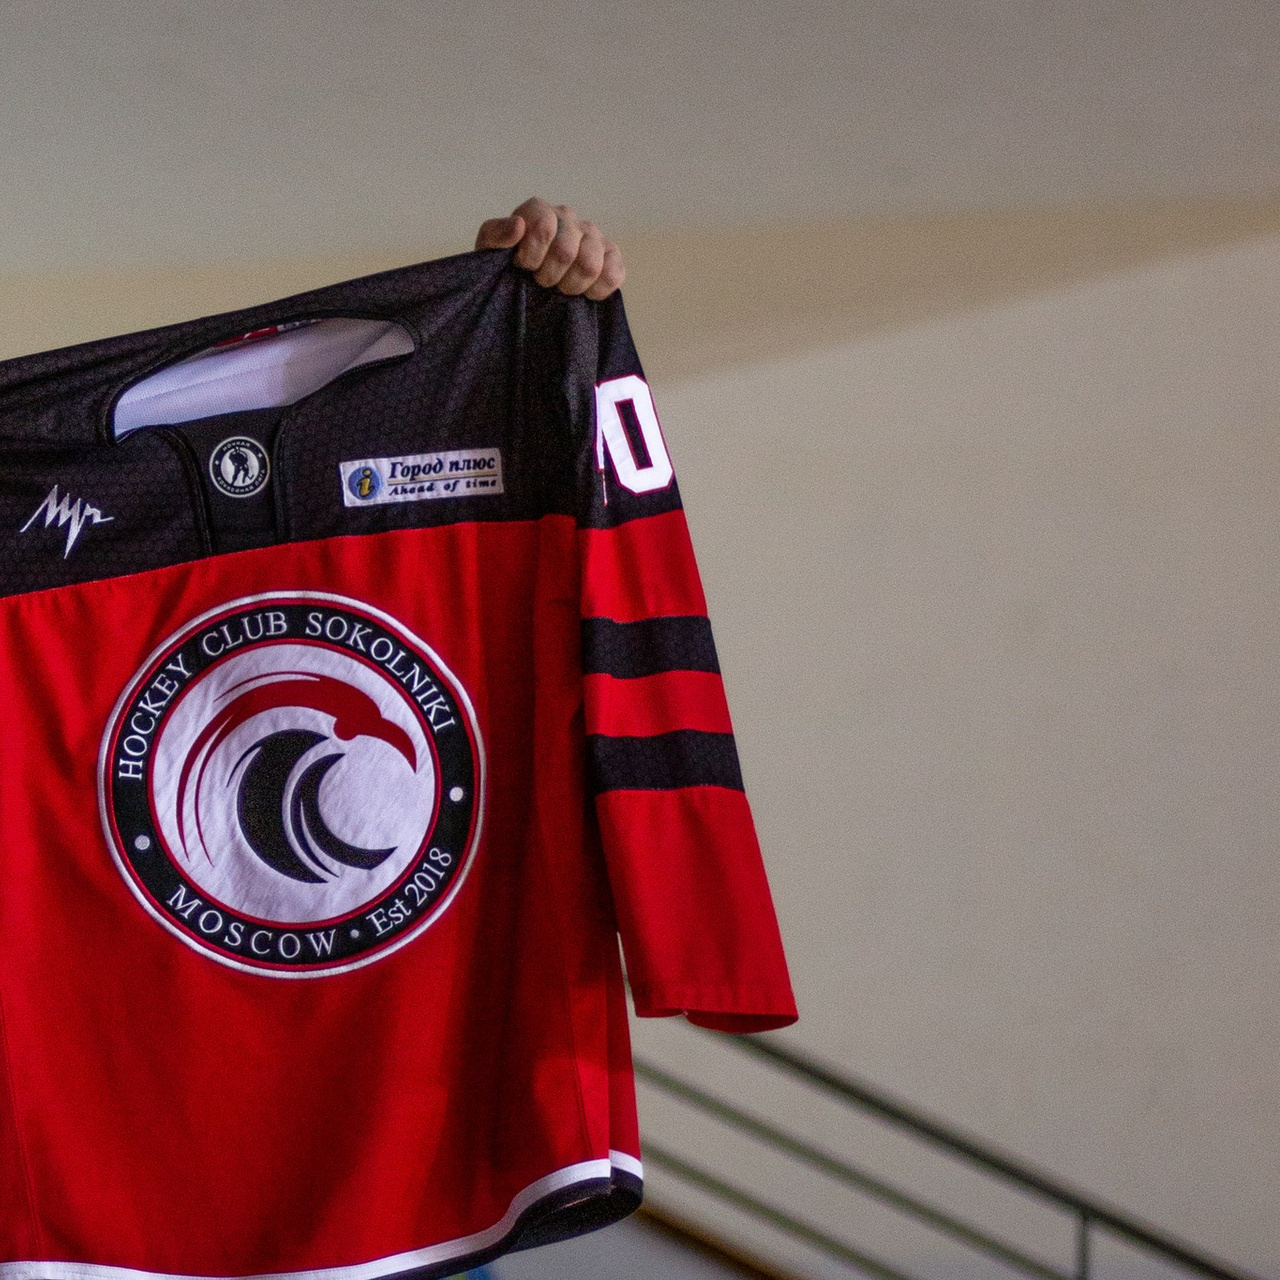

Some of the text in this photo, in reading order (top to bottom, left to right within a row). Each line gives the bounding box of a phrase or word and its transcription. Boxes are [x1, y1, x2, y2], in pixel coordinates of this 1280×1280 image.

[388, 456, 496, 481] Город плюс
[388, 478, 498, 496] Ahead of time
[118, 611, 457, 781] HOCKEY CLUB SOKOLNIKI
[166, 846, 453, 959] MOSCOW Est 2018
